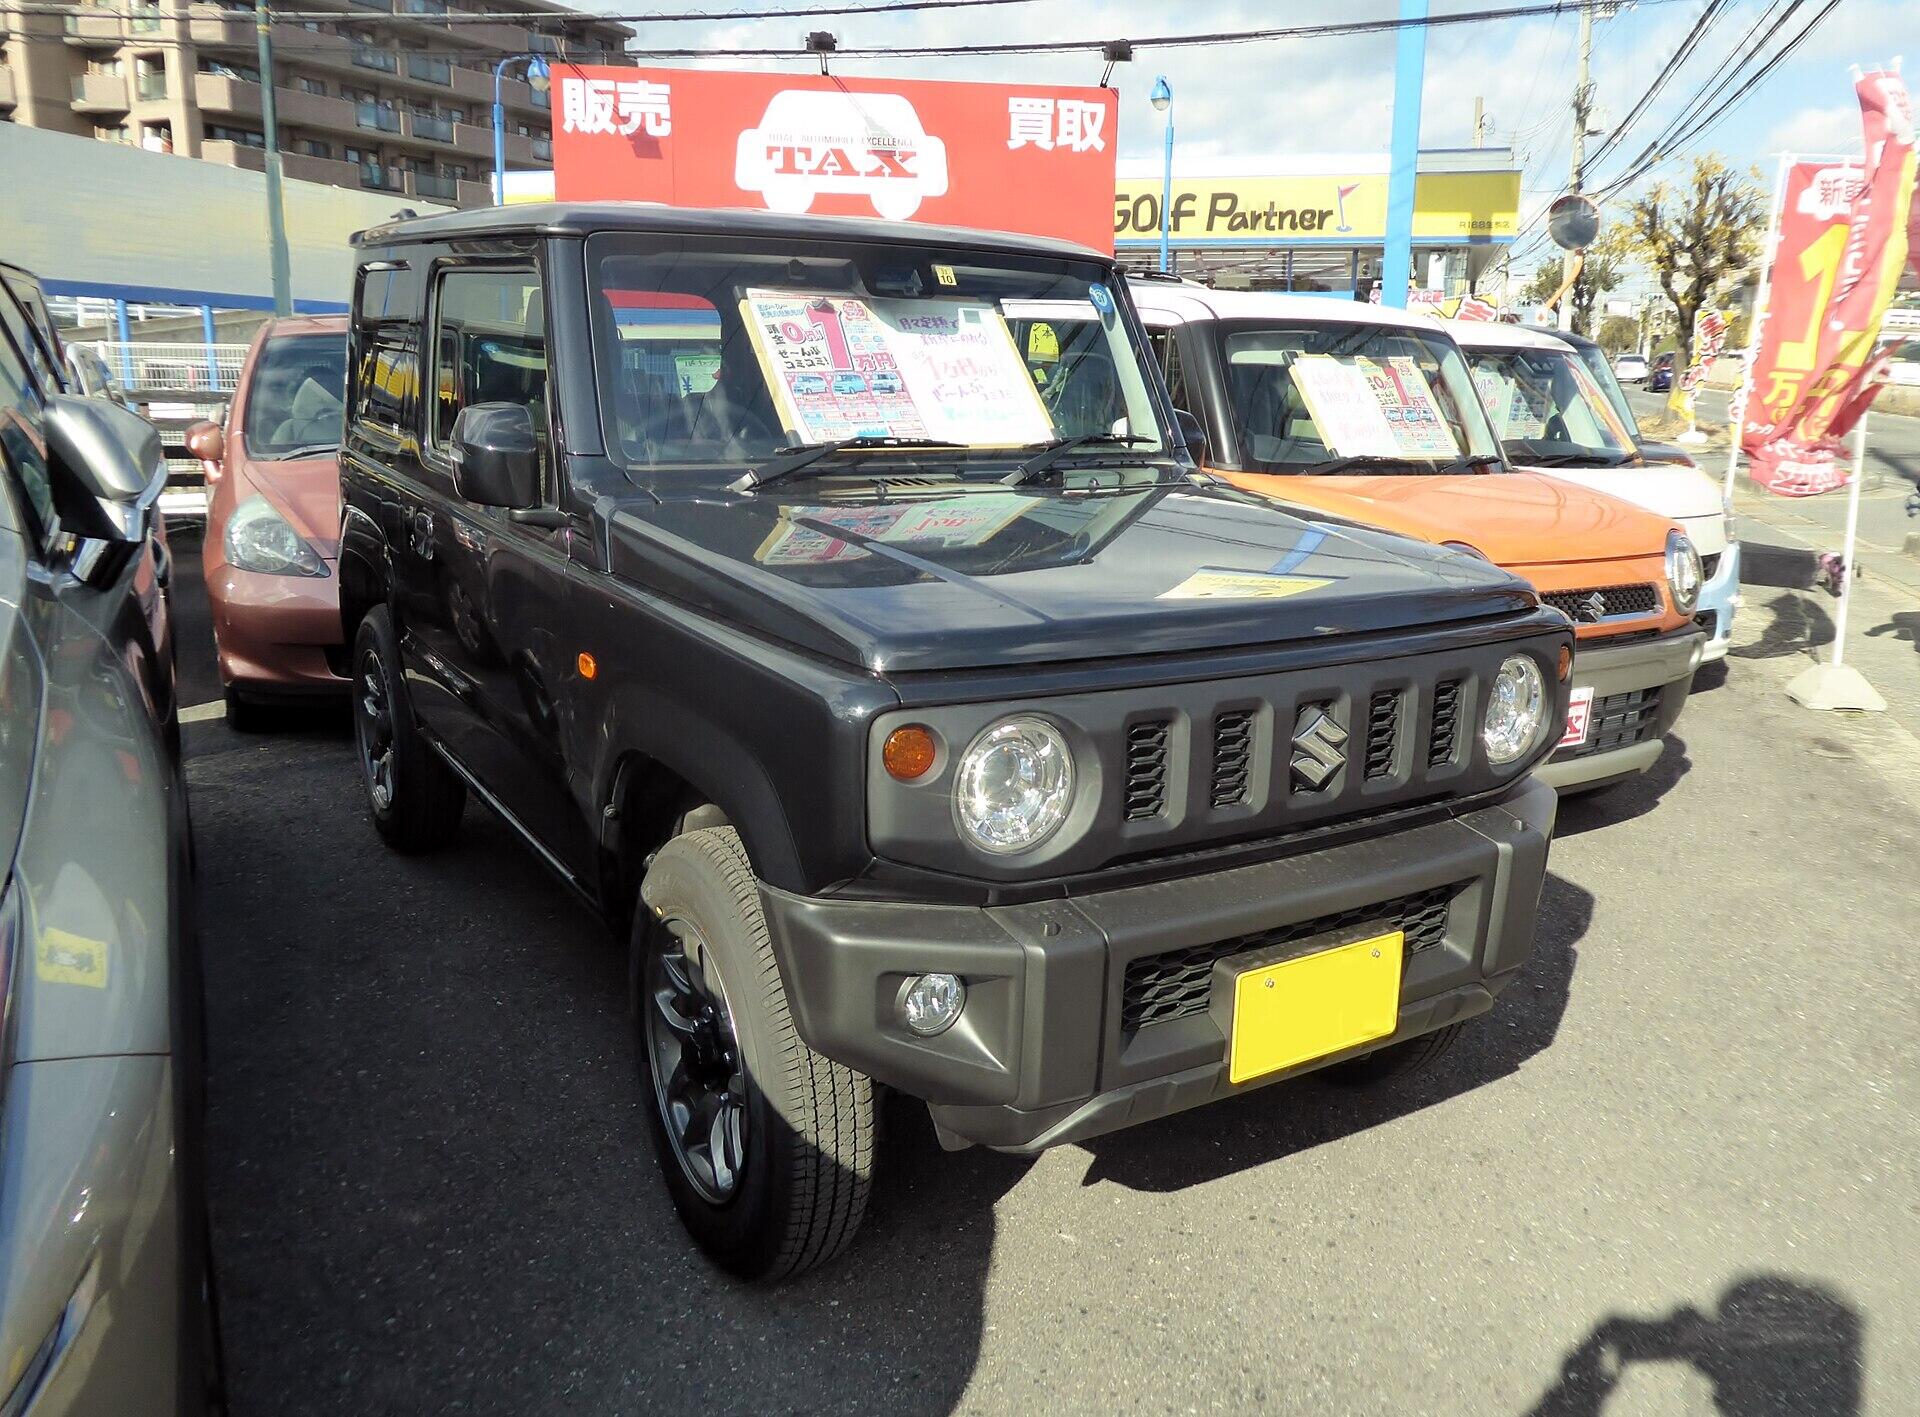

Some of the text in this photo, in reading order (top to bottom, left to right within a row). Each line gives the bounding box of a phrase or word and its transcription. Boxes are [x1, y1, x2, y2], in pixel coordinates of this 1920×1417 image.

[562, 78, 671, 137] 販売
[1007, 96, 1106, 152] 買取
[861, 136, 913, 147] EXCELLENCE
[766, 146, 918, 178] TAX
[1206, 192, 1334, 232] Partner
